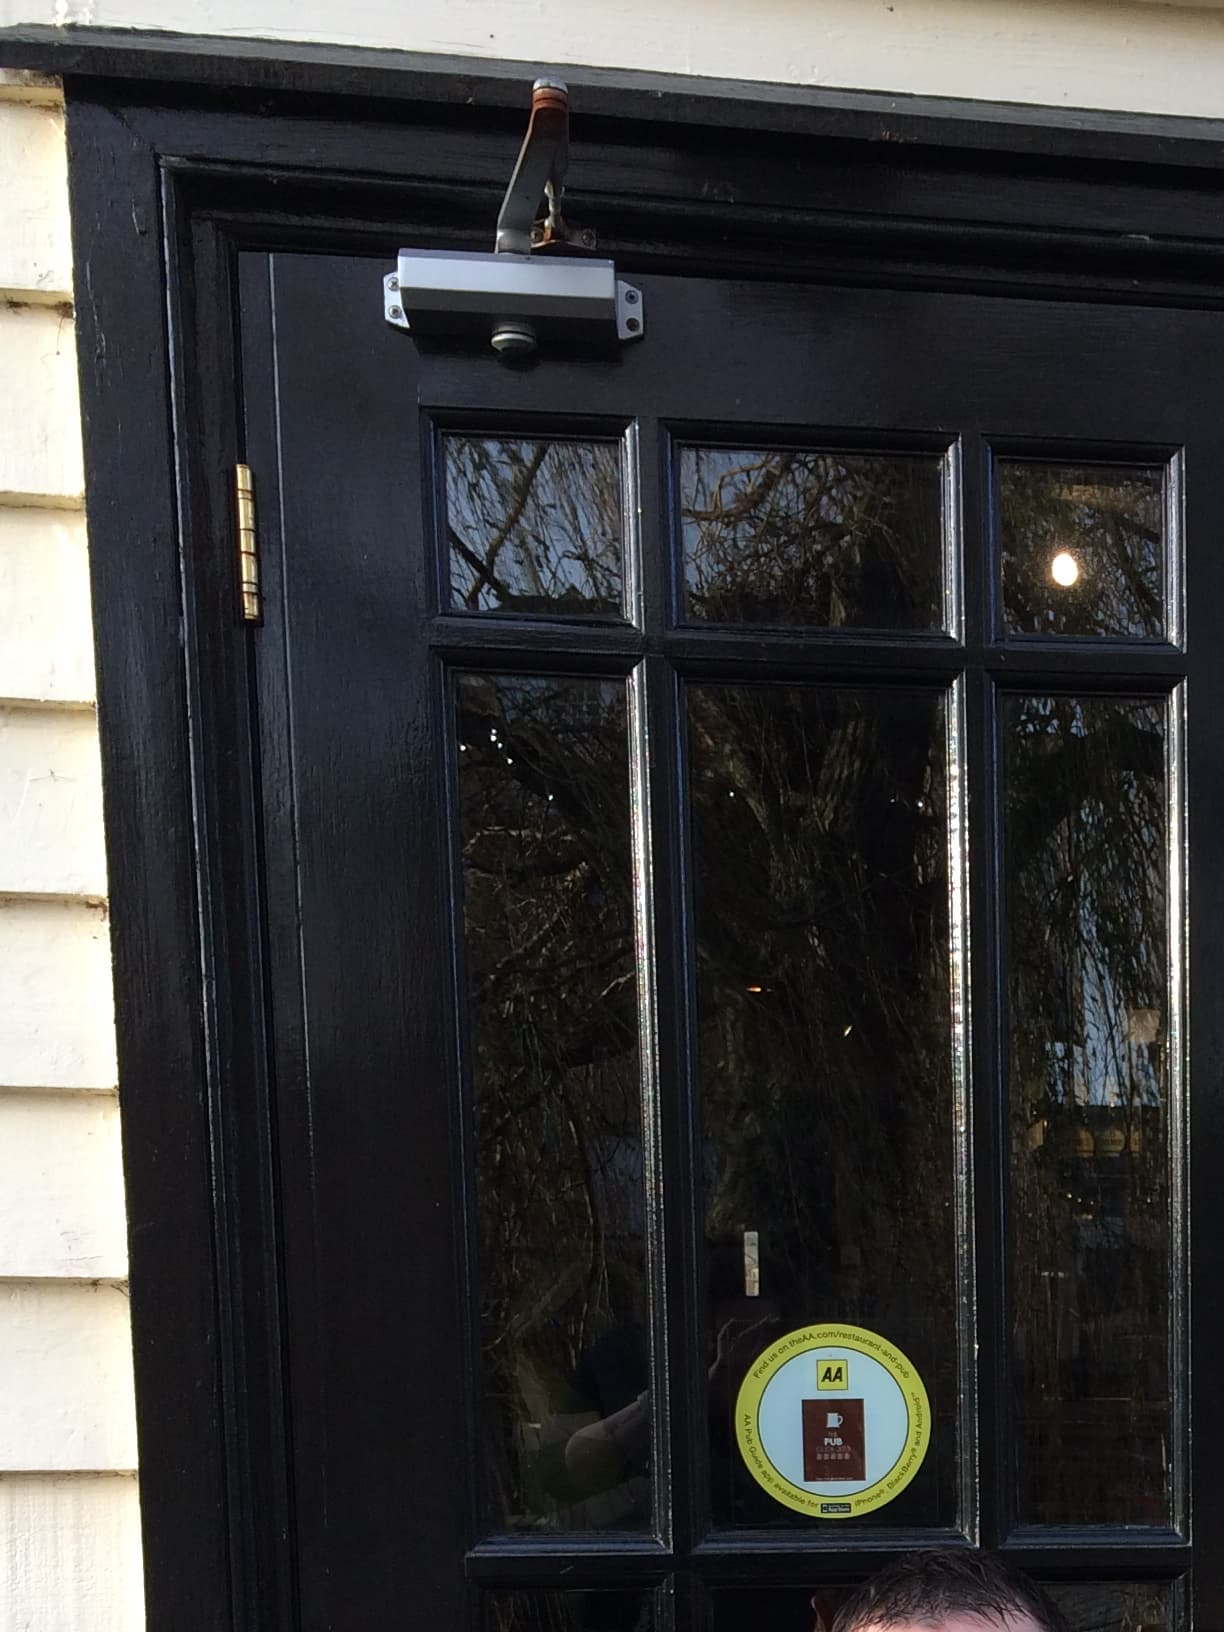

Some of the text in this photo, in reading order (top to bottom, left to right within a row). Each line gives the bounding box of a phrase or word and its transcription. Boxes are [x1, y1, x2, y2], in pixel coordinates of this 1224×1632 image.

[778, 1344, 789, 1354] on
[820, 1366, 843, 1383] AA
[824, 1437, 843, 1447] PUB
